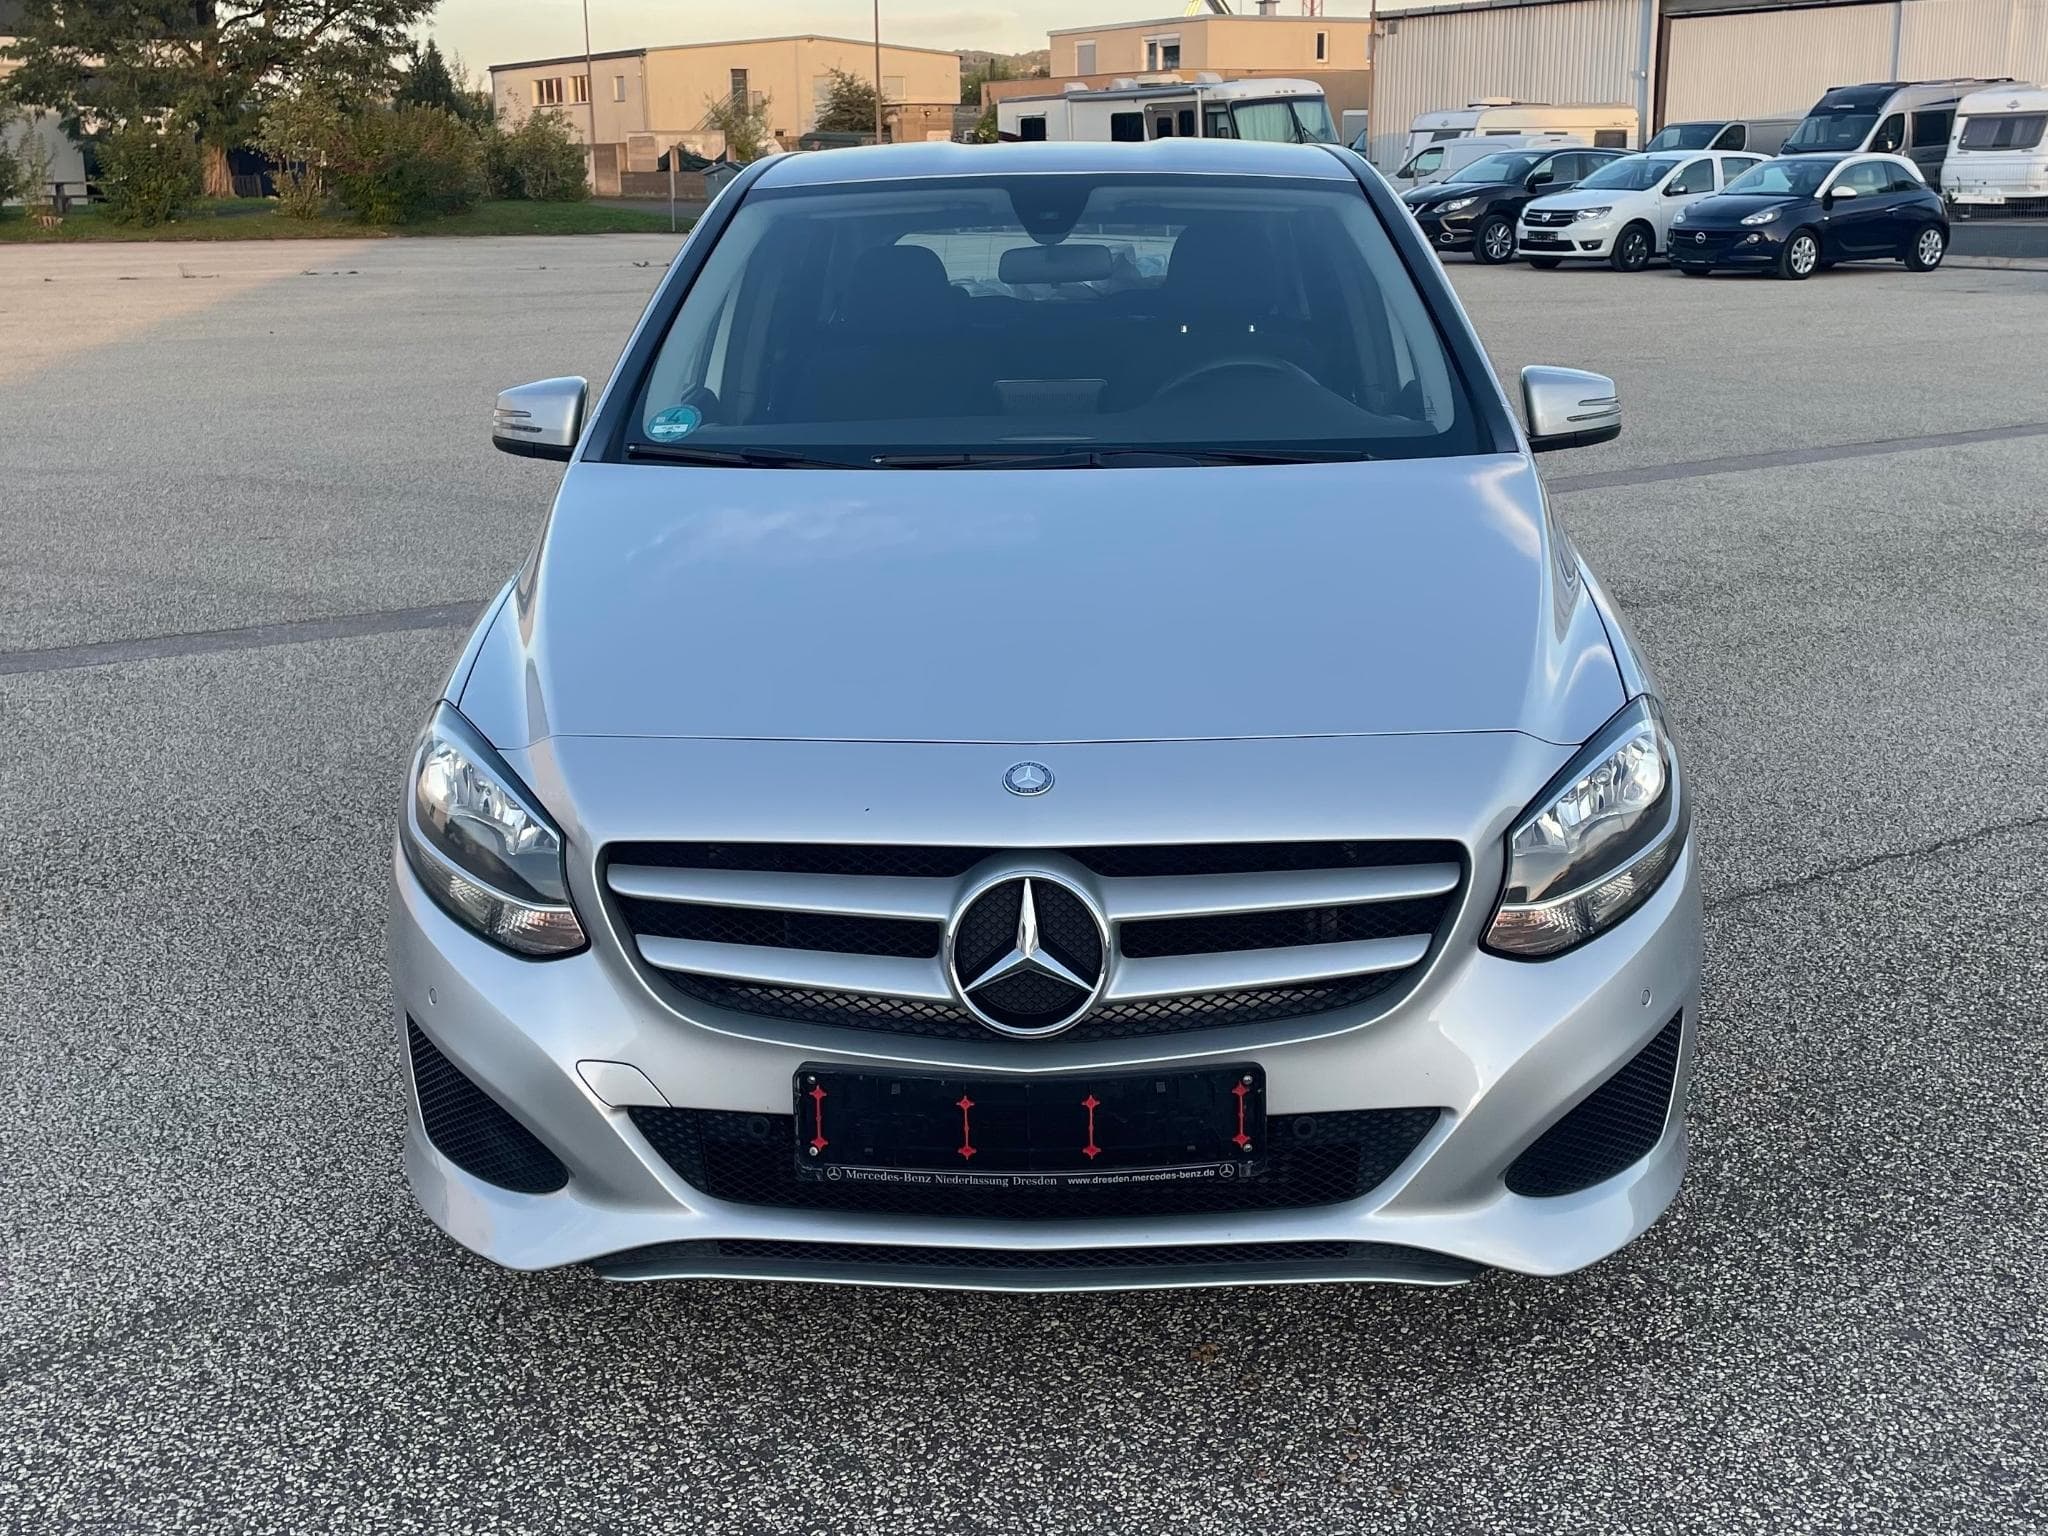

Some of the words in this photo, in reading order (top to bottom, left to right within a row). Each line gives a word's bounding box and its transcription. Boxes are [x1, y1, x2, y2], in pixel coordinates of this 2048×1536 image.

[667, 409, 681, 422] 4
[845, 1169, 932, 1183] Mercedes-Benz
[935, 1174, 1009, 1187] Niederlassung
[1013, 1176, 1057, 1186] Dresden
[1067, 1169, 1215, 1185] www.dresden.mercedes-benz.de
